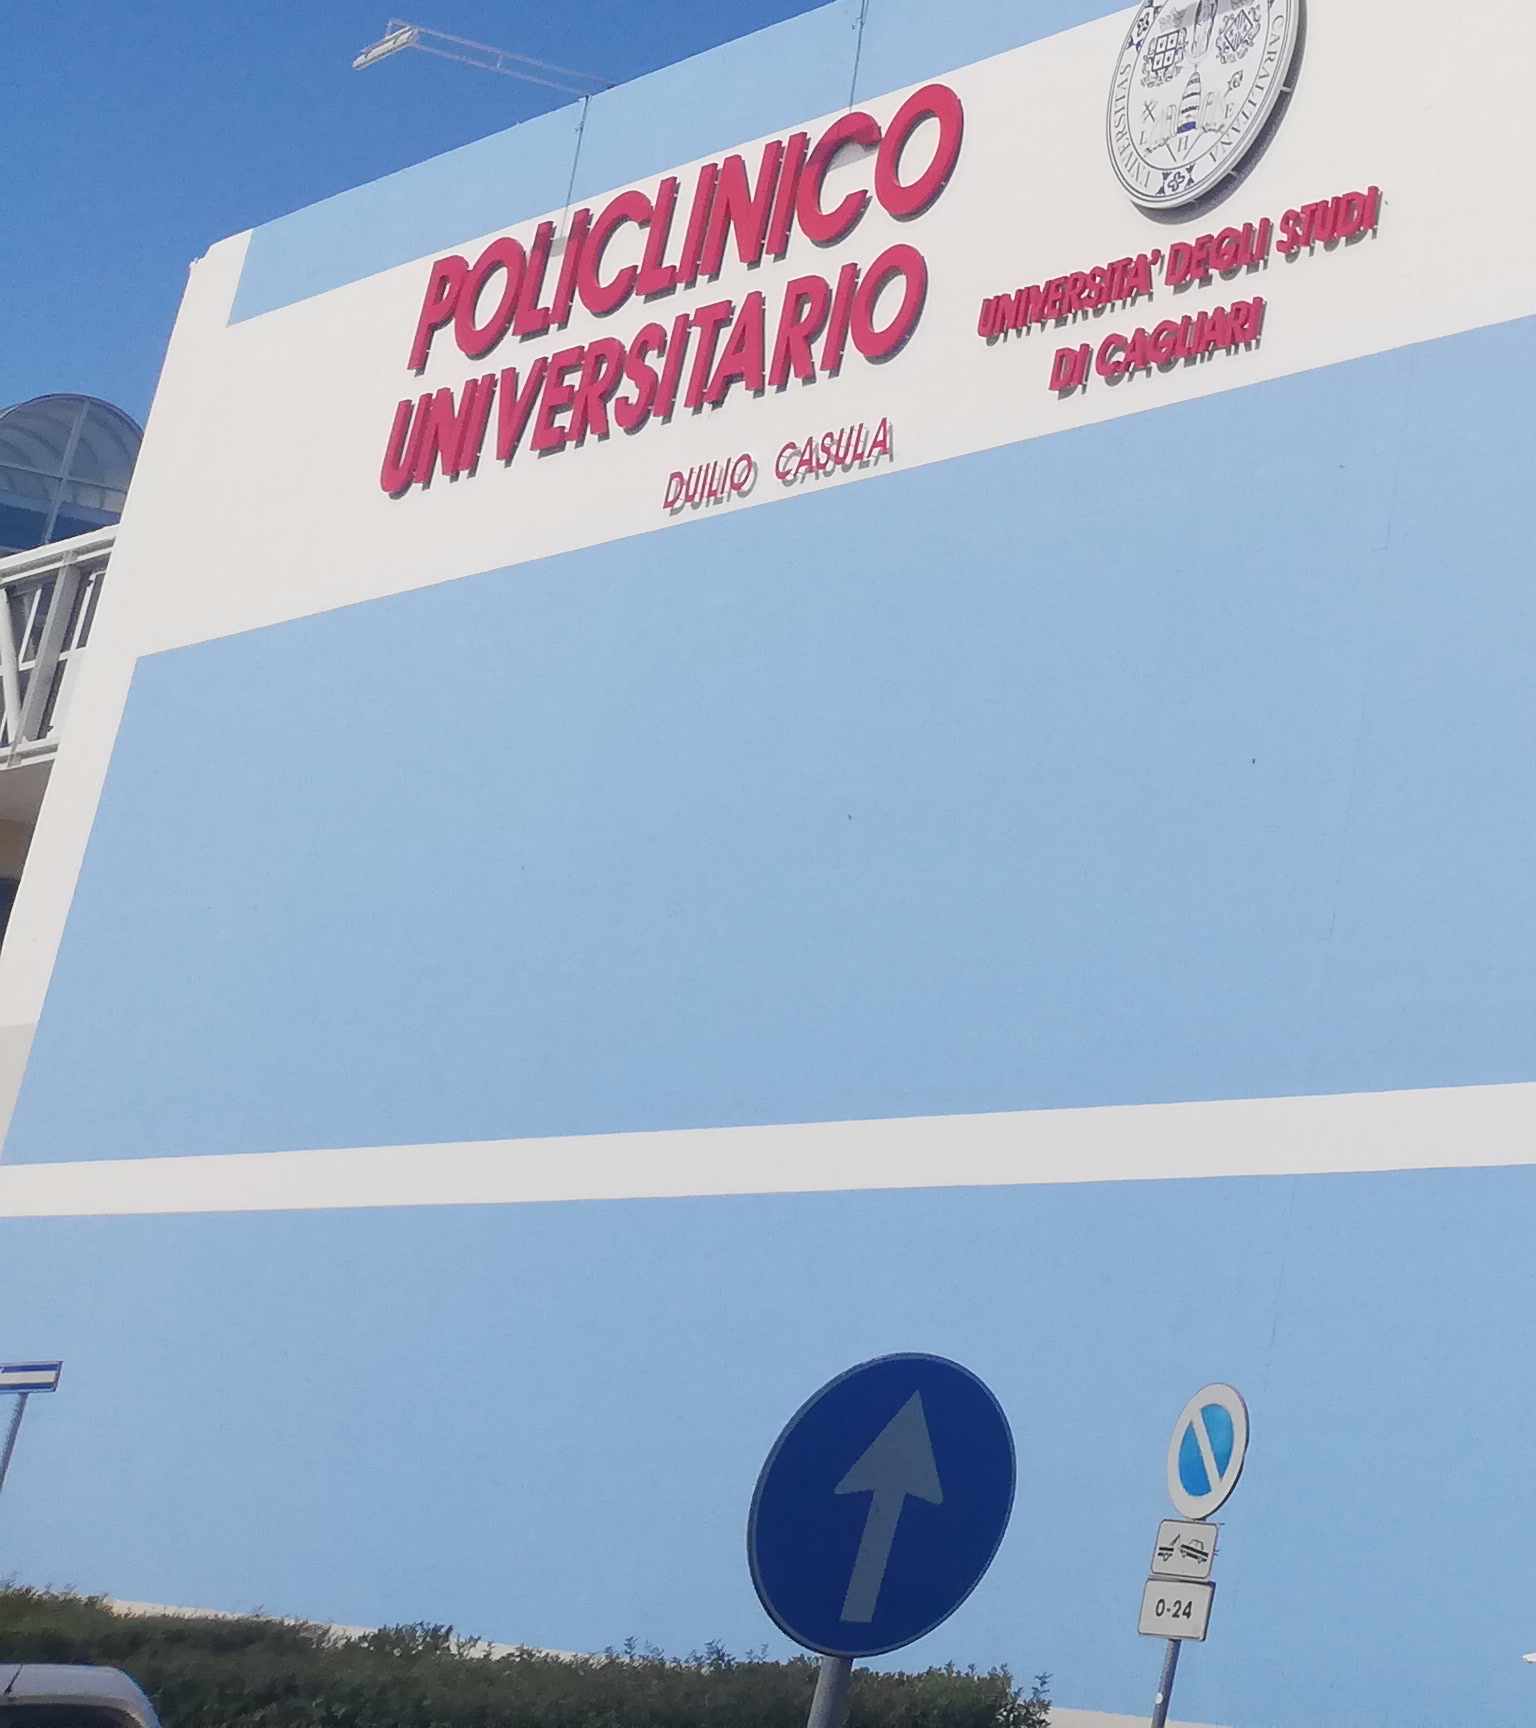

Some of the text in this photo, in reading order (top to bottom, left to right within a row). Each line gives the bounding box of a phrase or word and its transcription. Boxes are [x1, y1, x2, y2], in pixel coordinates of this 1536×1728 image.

[406, 83, 964, 371] POLICLINICO
[978, 185, 1381, 338] UNIVERSITA' DEGLI STUDI
[380, 243, 928, 494] UNIVERSITARIO
[1048, 296, 1267, 392] DI CAGLIARI
[662, 417, 891, 510] DUILIO CASULA
